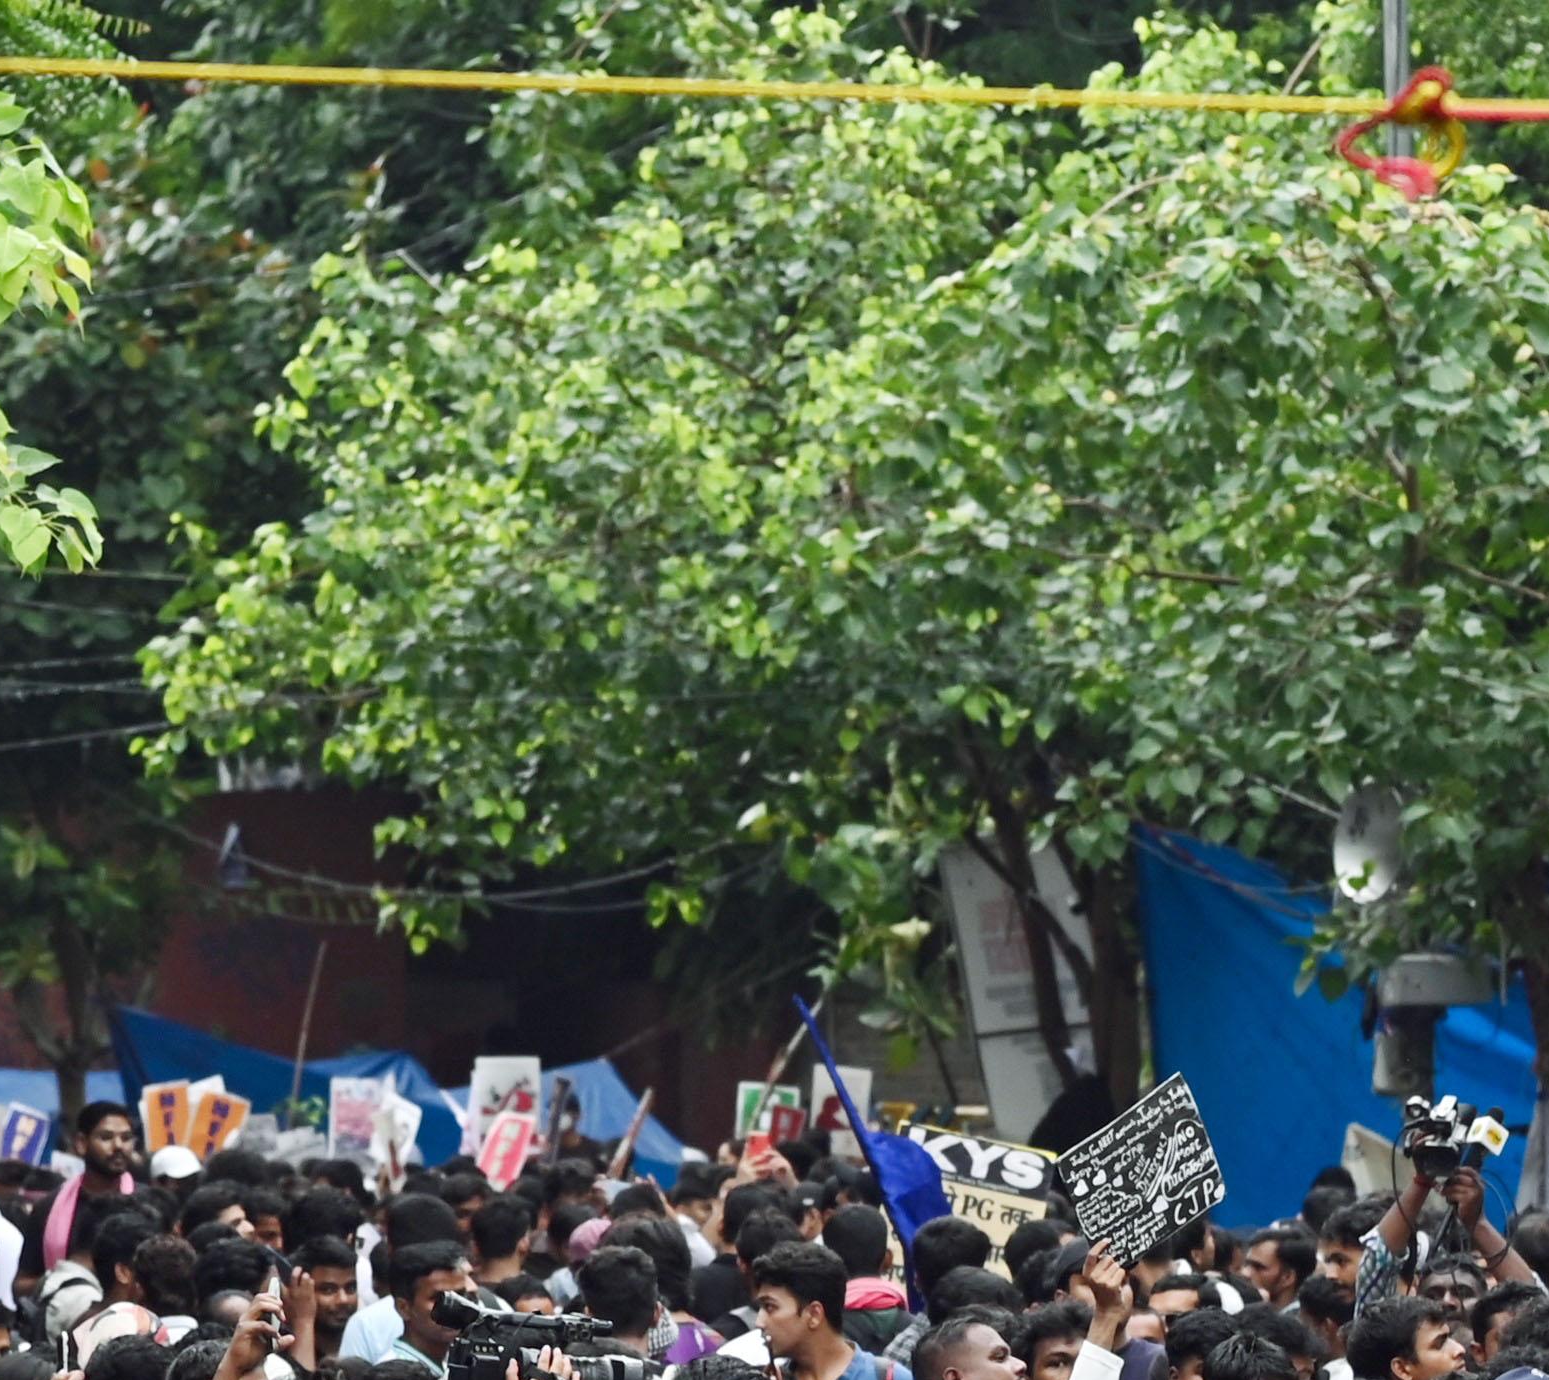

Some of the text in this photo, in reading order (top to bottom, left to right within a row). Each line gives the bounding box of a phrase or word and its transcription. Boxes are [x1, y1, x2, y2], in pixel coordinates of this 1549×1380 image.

[1177, 1126, 1196, 1144] NO
[908, 1126, 1046, 1190] KYS
[961, 1193, 995, 1221] PG
[1173, 1178, 1215, 1226] CJP
